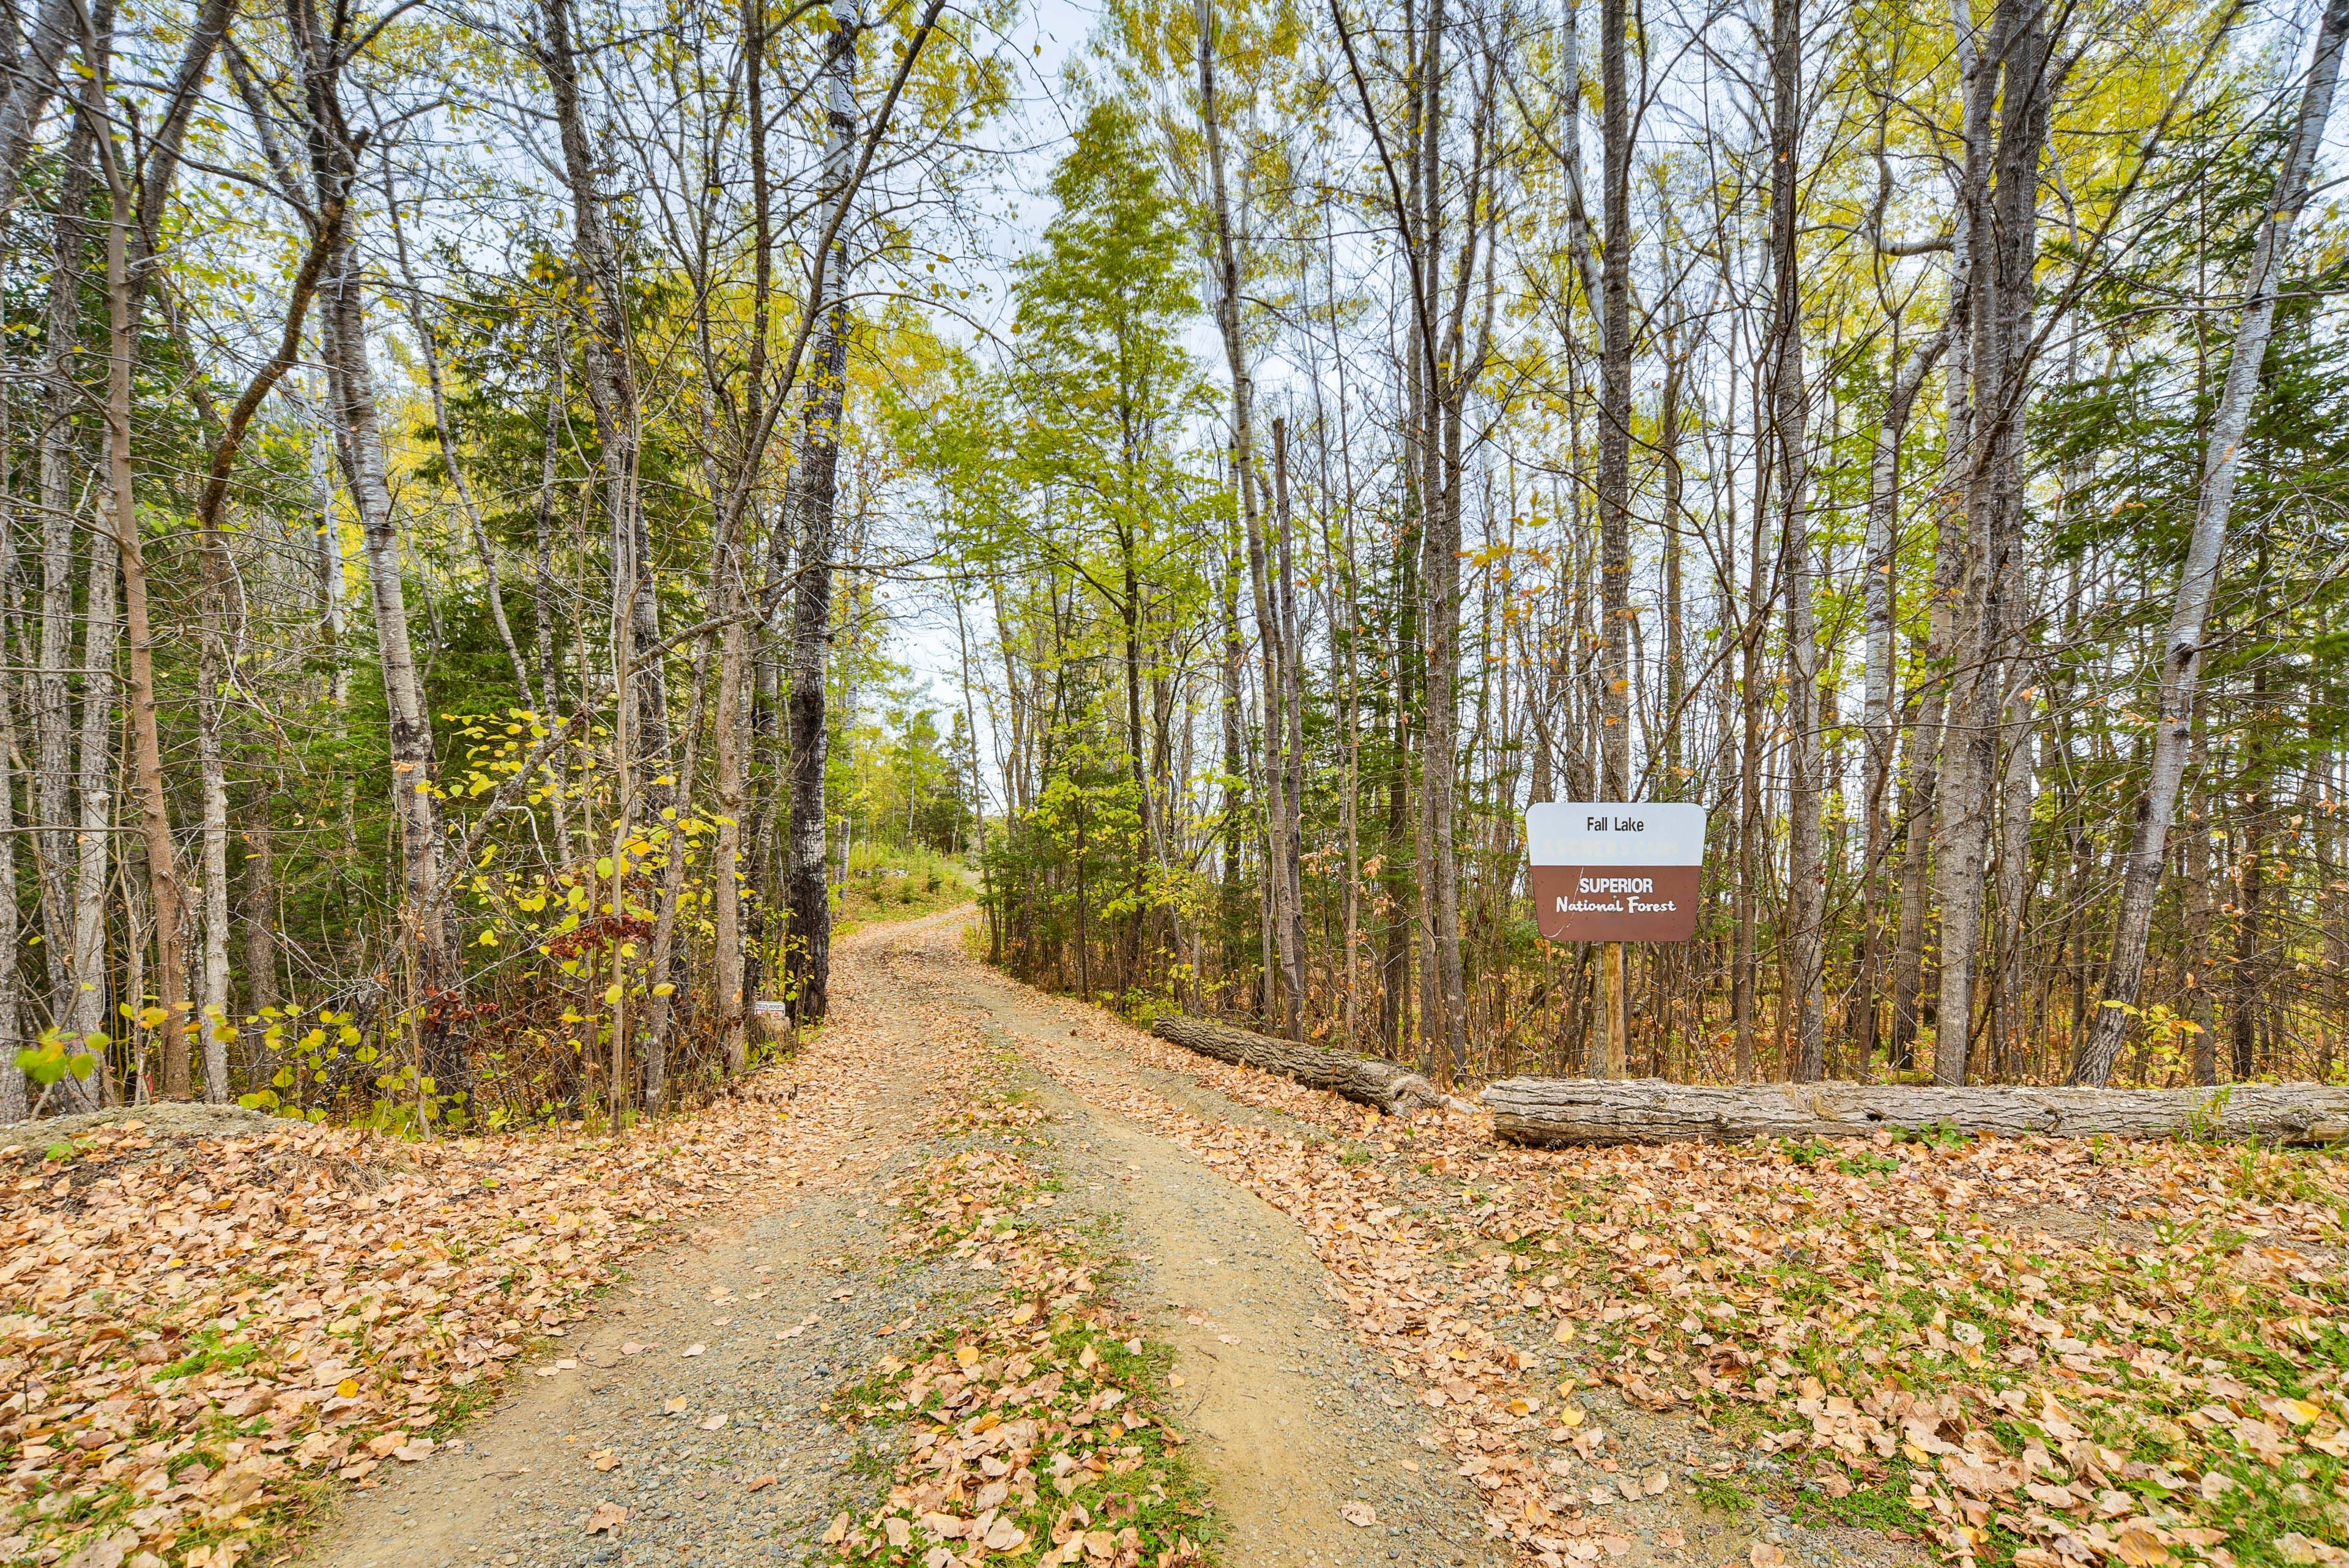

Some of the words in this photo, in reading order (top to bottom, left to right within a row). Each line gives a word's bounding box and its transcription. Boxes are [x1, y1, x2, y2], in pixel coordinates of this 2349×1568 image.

[1587, 817, 1608, 831] Fall
[1614, 817, 1644, 832] Lake
[1579, 878, 1653, 893] SUPERIOR
[1557, 896, 1624, 913] National
[1626, 896, 1677, 913] Forest
